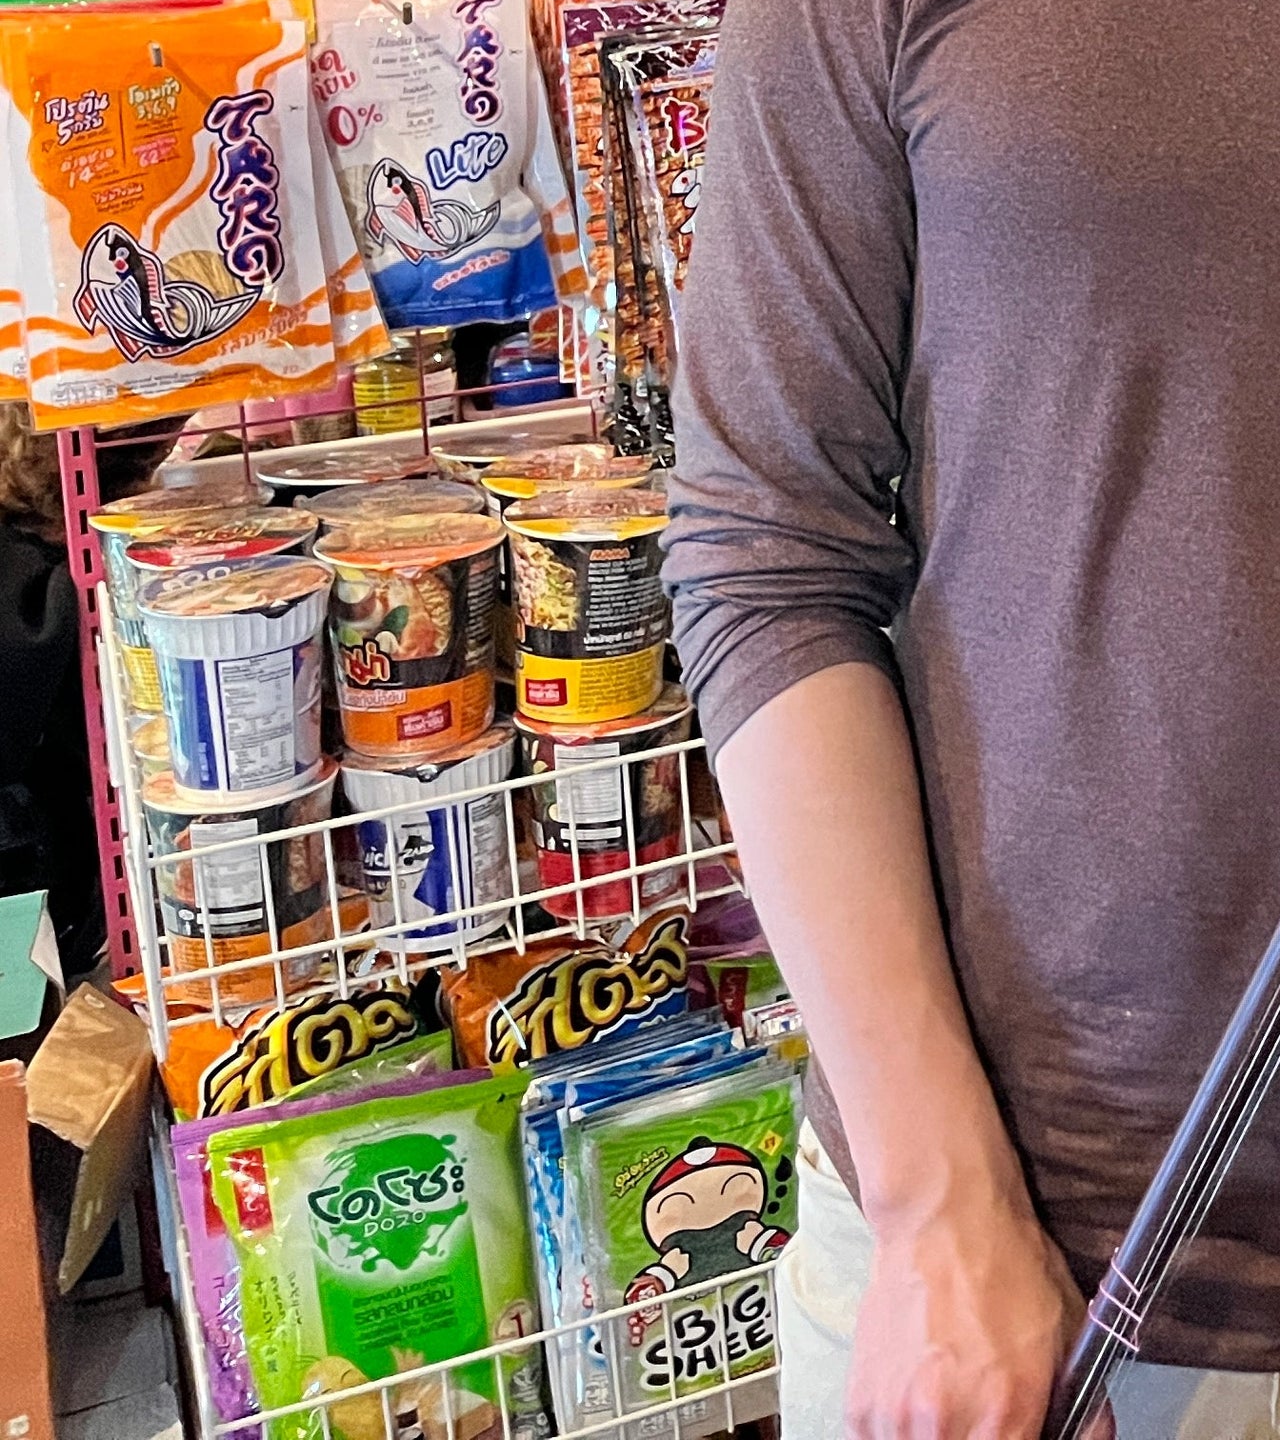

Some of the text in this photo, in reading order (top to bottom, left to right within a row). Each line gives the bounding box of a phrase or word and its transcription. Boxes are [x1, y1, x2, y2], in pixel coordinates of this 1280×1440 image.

[204, 90, 285, 287] TARO
[426, 130, 508, 190] Lite
[307, 1164, 465, 1225] โดโซะ
[363, 1210, 427, 1238] DOZO
[645, 1313, 774, 1387] SHEE
